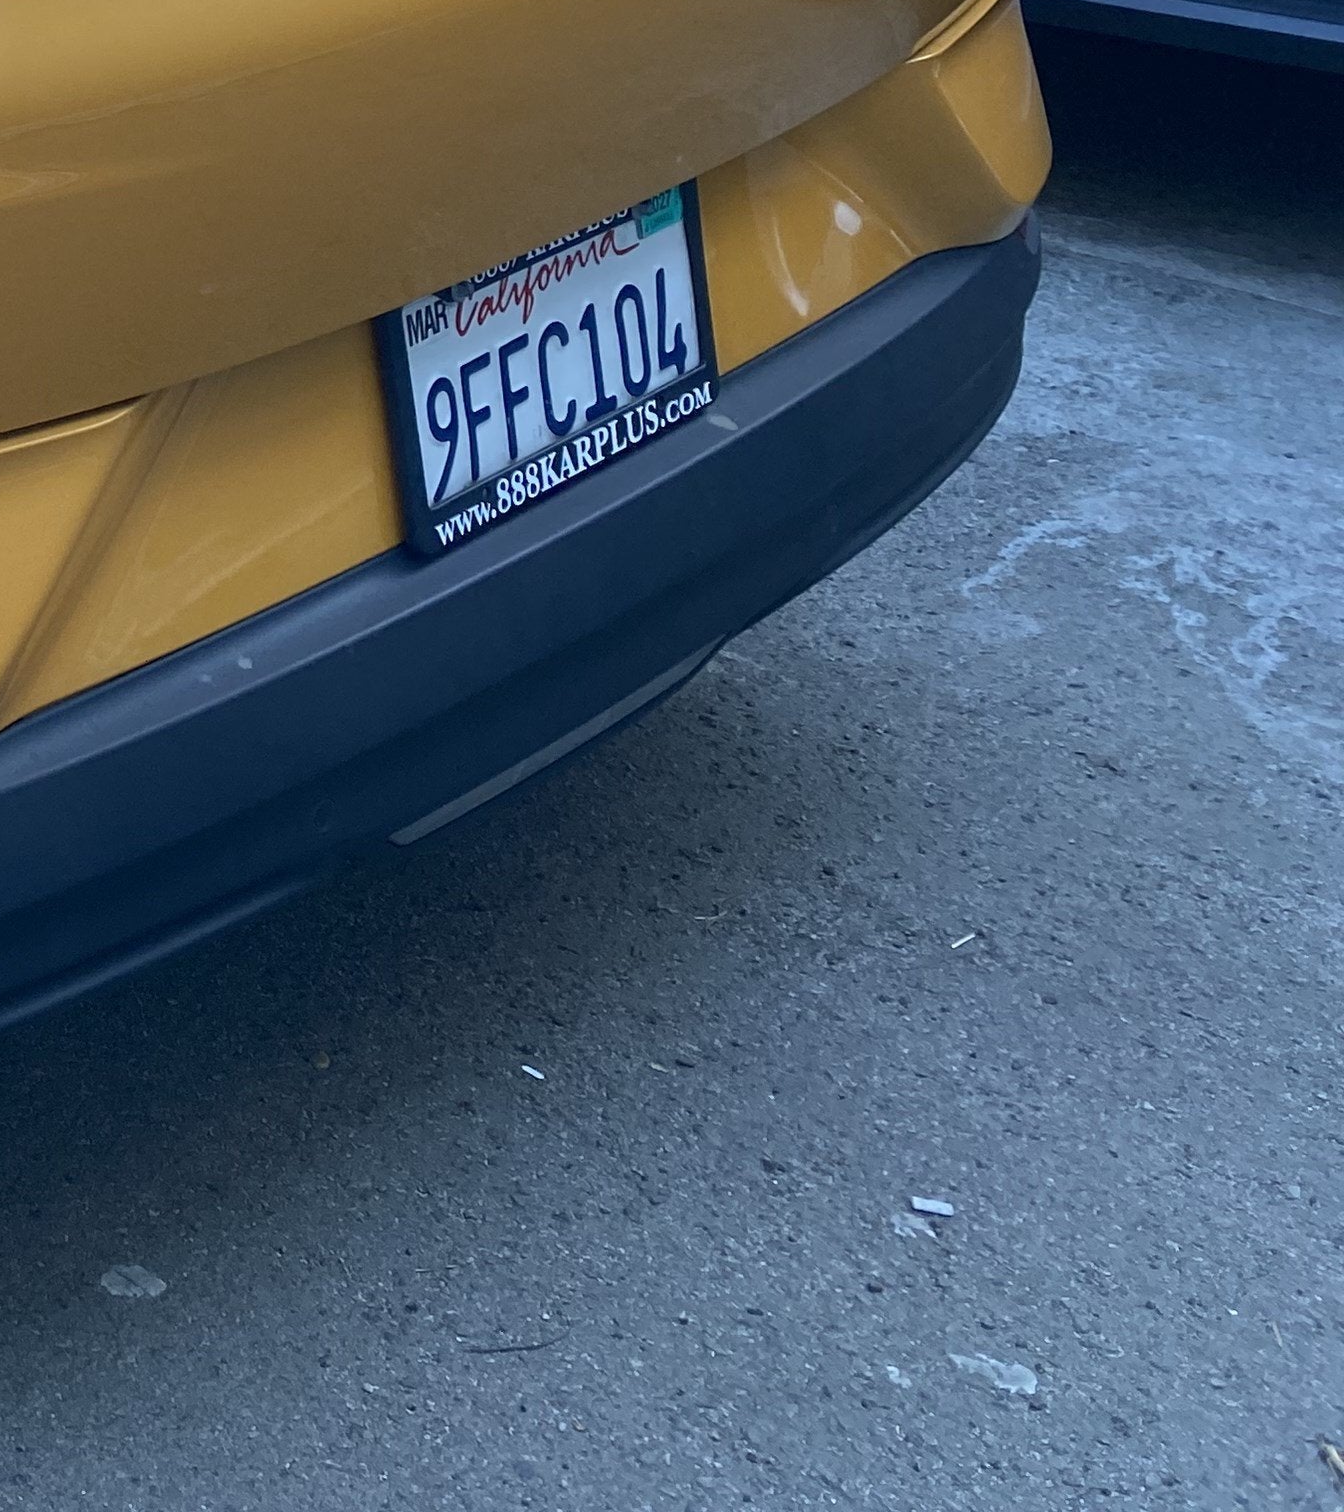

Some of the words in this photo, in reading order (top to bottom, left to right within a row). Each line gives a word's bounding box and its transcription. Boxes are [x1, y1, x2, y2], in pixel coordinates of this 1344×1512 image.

[406, 304, 448, 346] MAR
[455, 228, 640, 337] California
[426, 267, 689, 503] 9FFC104
